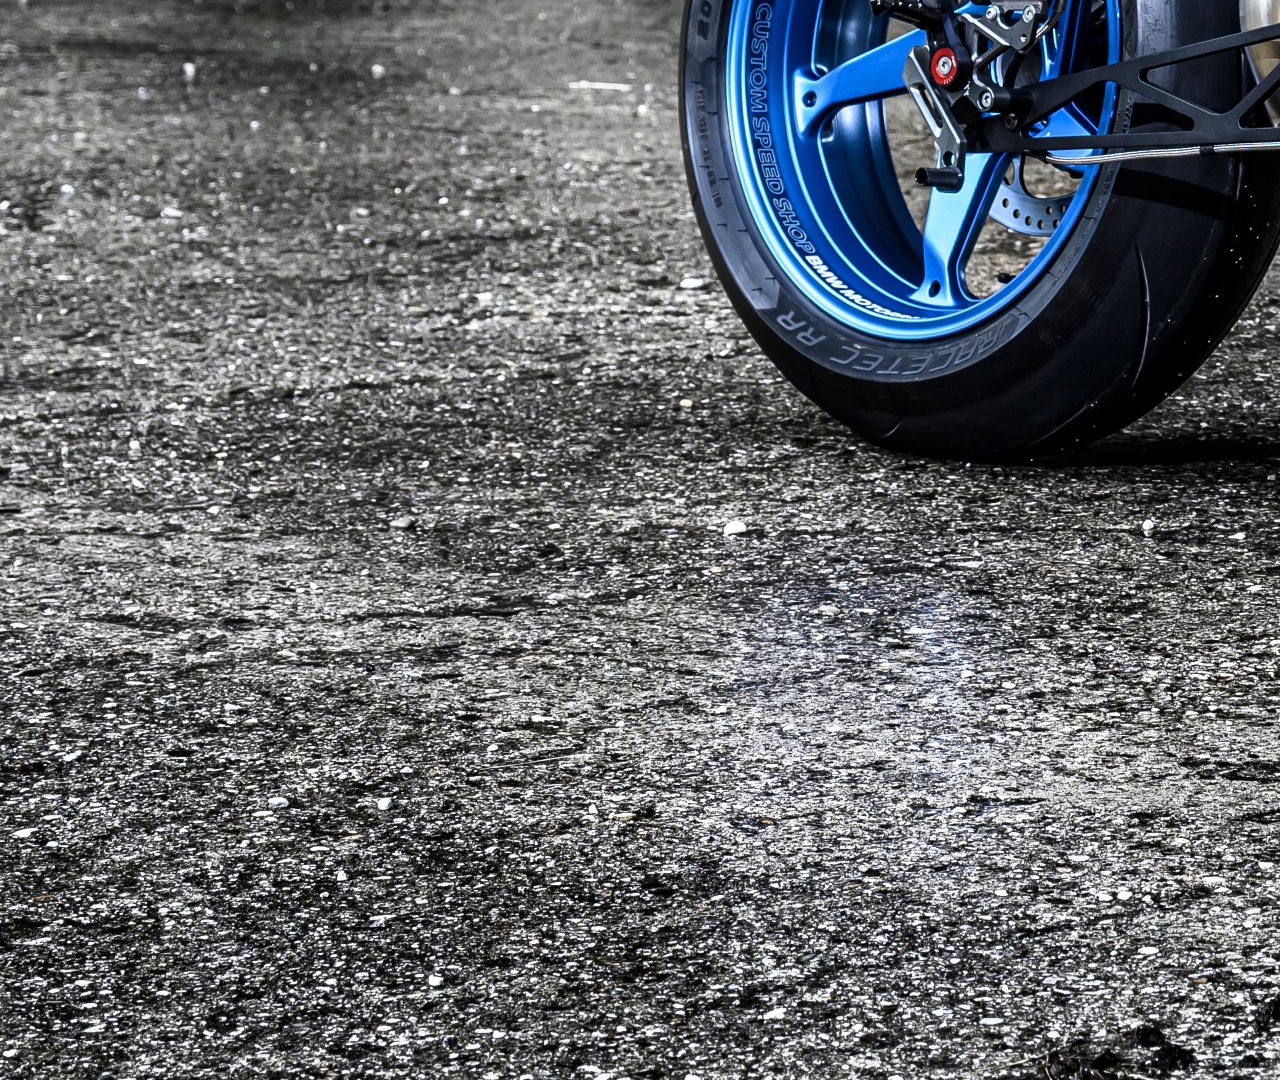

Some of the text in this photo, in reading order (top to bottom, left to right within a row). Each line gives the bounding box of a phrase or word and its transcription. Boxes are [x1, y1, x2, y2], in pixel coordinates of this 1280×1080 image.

[750, 2, 772, 114] CUSTOM
[752, 116, 784, 195] SPEED
[773, 196, 817, 254] SHOP
[804, 254, 848, 295] BMW
[776, 310, 1005, 375] RACETEC RR
